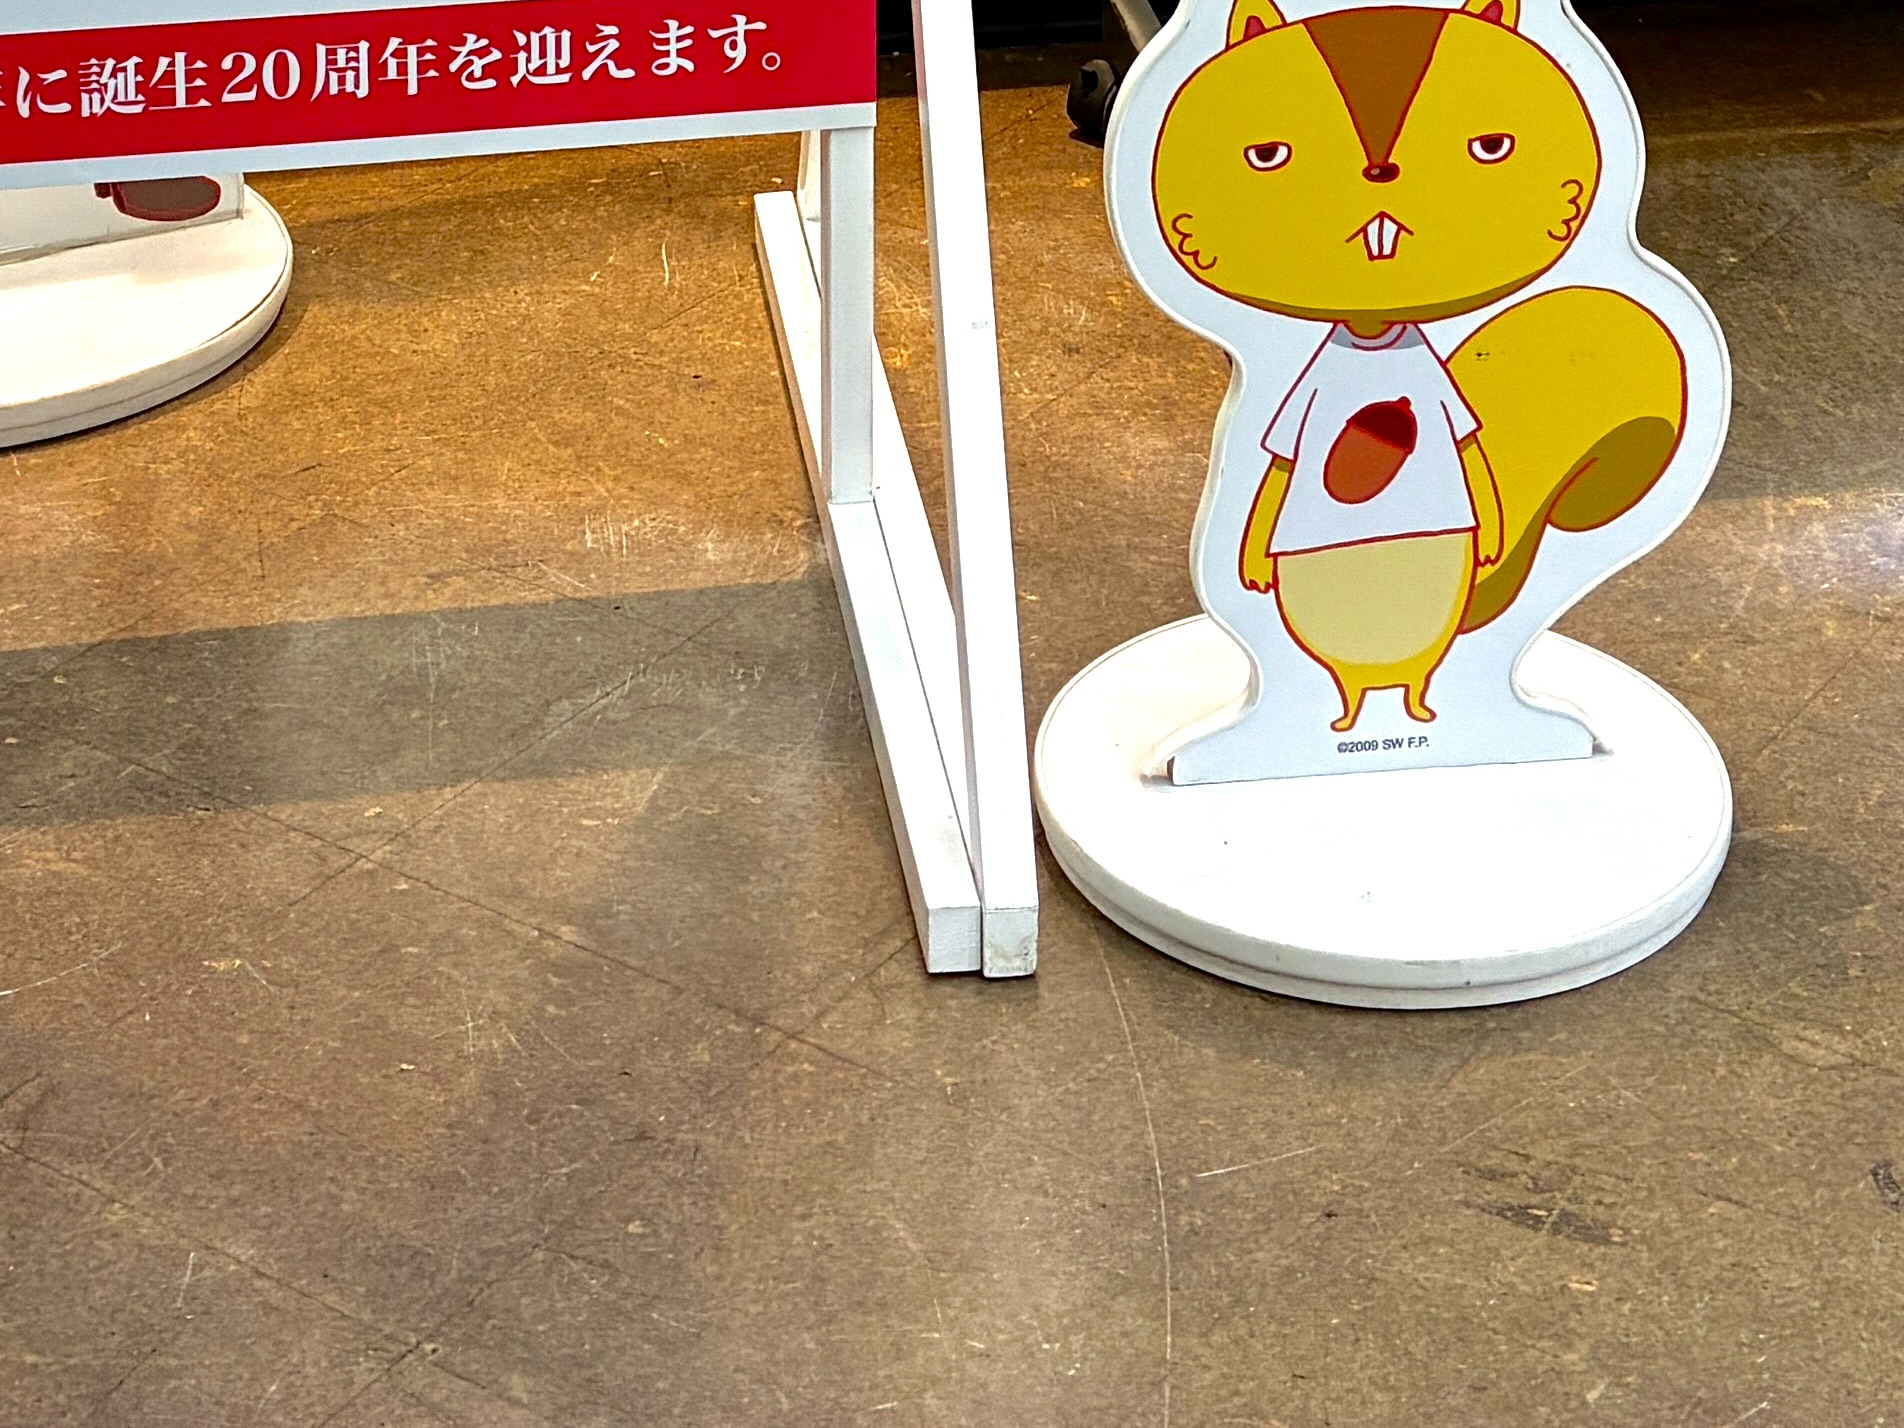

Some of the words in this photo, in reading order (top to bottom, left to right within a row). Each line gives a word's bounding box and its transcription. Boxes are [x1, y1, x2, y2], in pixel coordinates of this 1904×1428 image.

[1337, 739, 1379, 753] ©2009
[1382, 737, 1404, 751] SW
[1408, 736, 1430, 748] F.P.
